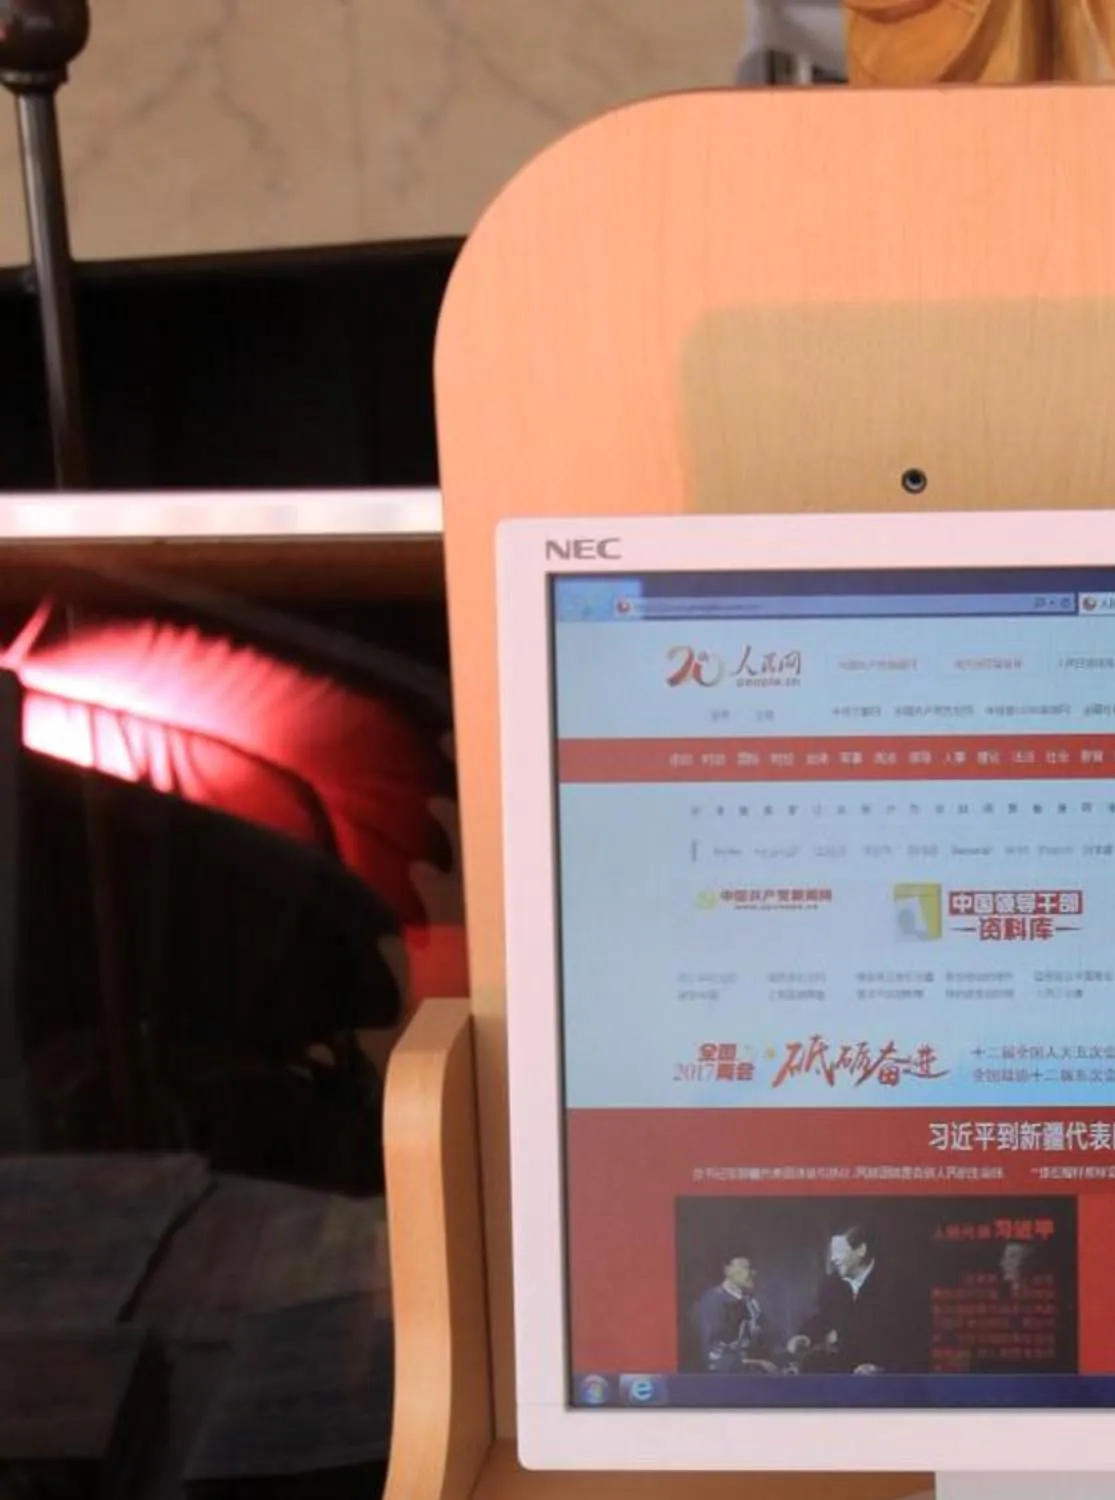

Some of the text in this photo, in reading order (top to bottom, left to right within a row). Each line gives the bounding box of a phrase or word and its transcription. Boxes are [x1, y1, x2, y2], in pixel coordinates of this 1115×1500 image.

[545, 538, 622, 560] NEC
[730, 644, 801, 677] 人民网
[951, 892, 1080, 914] 中国领导干部
[979, 917, 1053, 941] 资料库
[699, 1044, 738, 1061] 全国
[771, 1034, 951, 1088] 砥砺奋进
